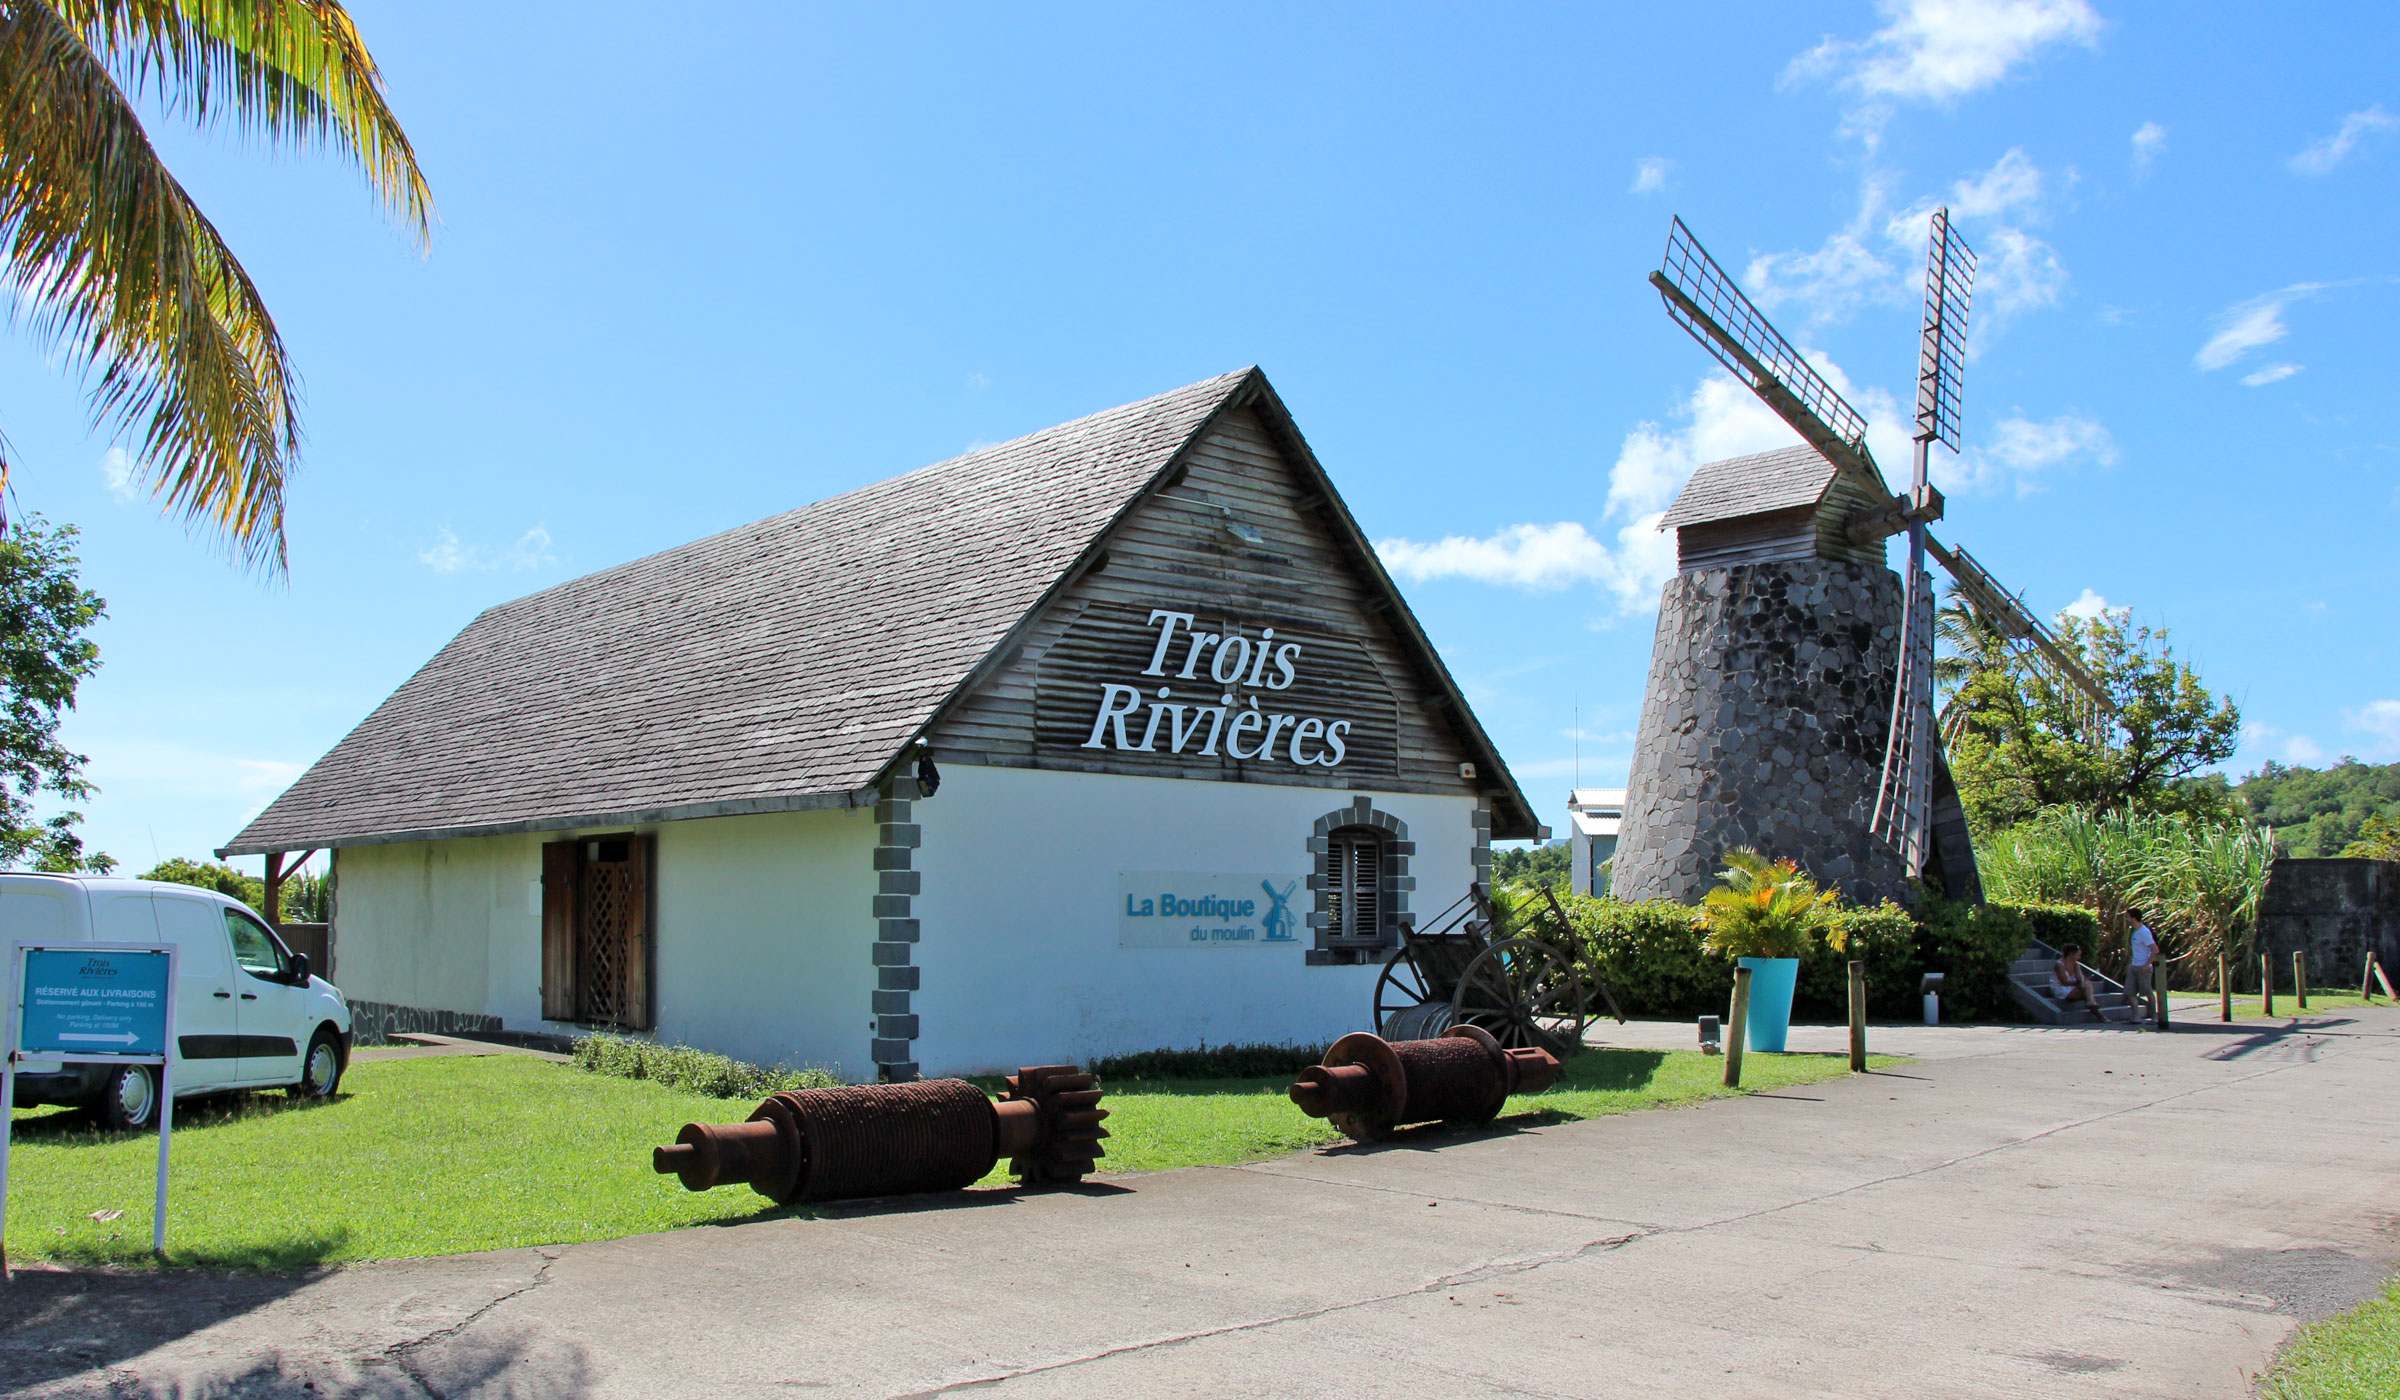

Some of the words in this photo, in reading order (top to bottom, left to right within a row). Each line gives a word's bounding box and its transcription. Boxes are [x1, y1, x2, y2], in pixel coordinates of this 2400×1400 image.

[1141, 608, 1301, 690] Trois
[1081, 682, 1350, 767] Rivières
[1127, 893, 1154, 917] La
[1160, 893, 1255, 922] Boutique
[1191, 925, 1208, 941] du
[1212, 925, 1255, 941] moulin
[35, 986, 78, 997] RÉSERVÉ
[80, 989, 99, 997] AUX
[101, 989, 157, 999] LIVRAISONS
